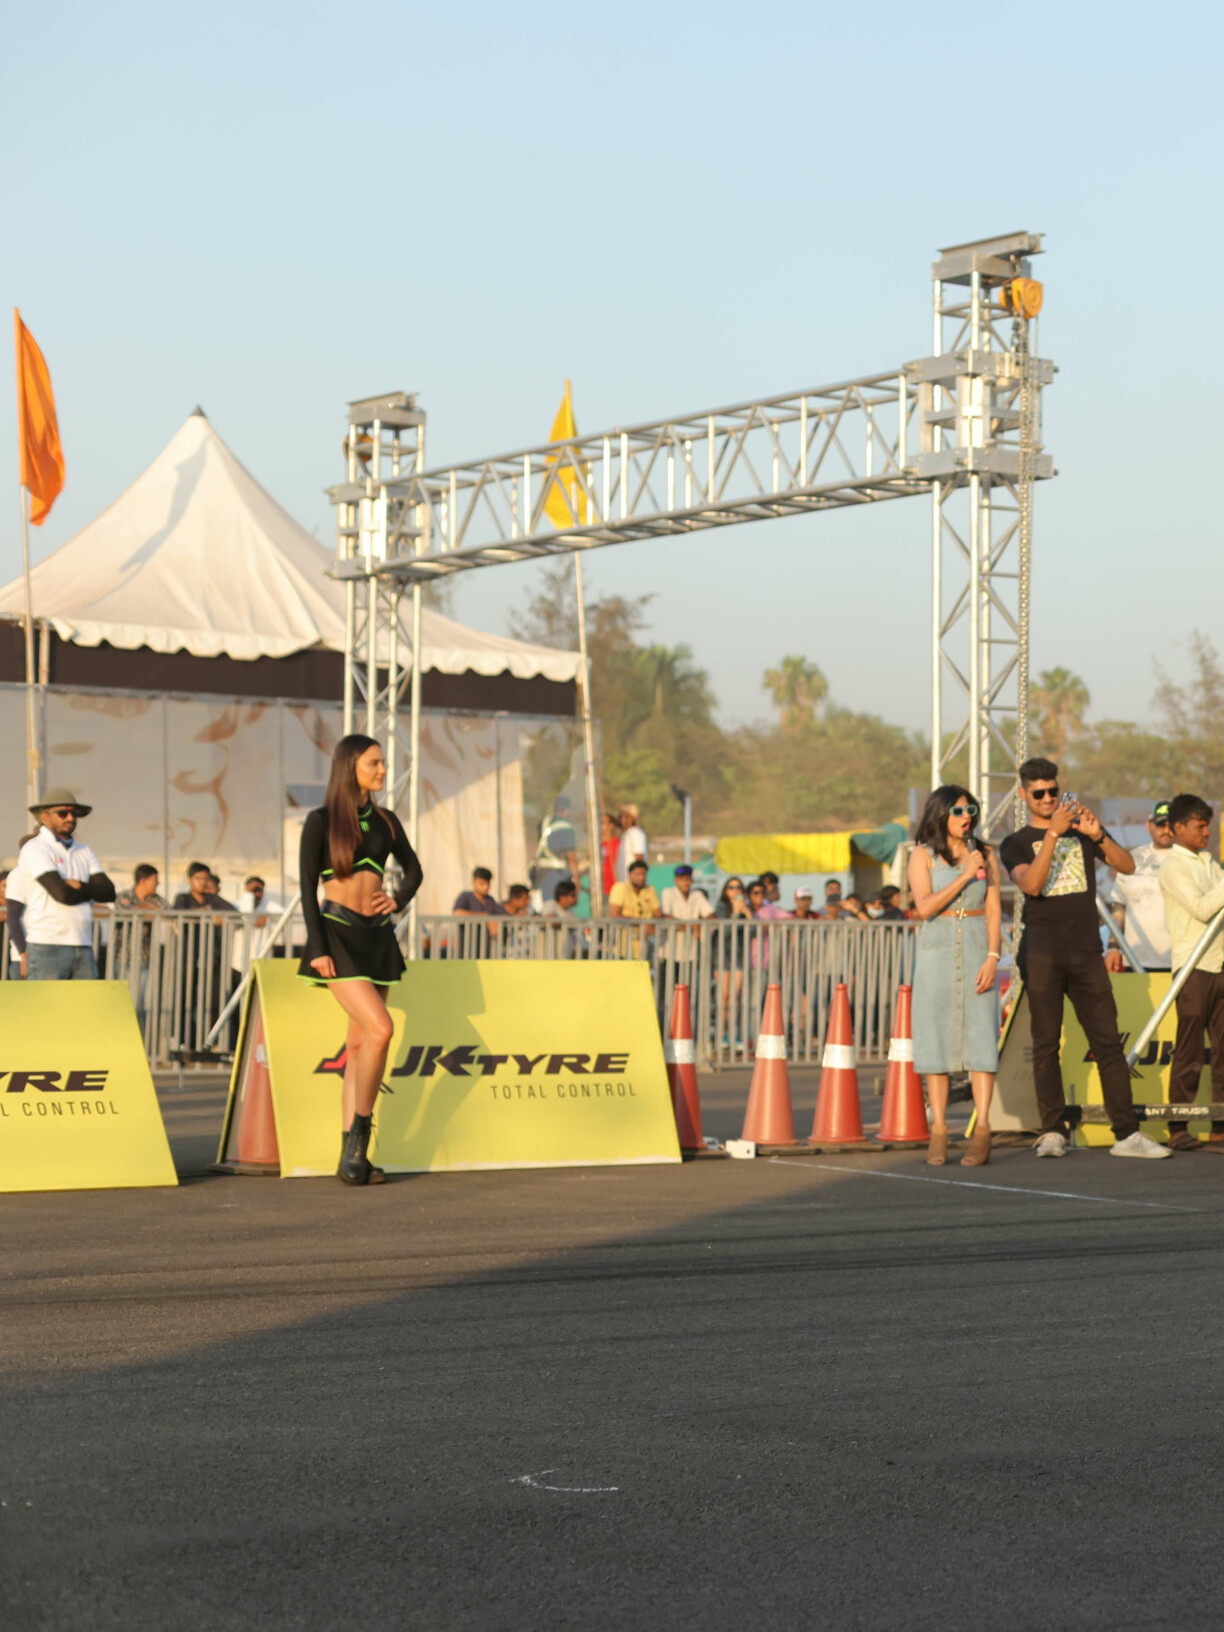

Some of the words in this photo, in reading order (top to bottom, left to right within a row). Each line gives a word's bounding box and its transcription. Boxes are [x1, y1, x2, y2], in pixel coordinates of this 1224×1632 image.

[0, 1070, 109, 1093] RE
[490, 1084, 548, 1100] TOTAL
[557, 1083, 637, 1099] CONTROL
[22, 1100, 119, 1117] CONTROL
